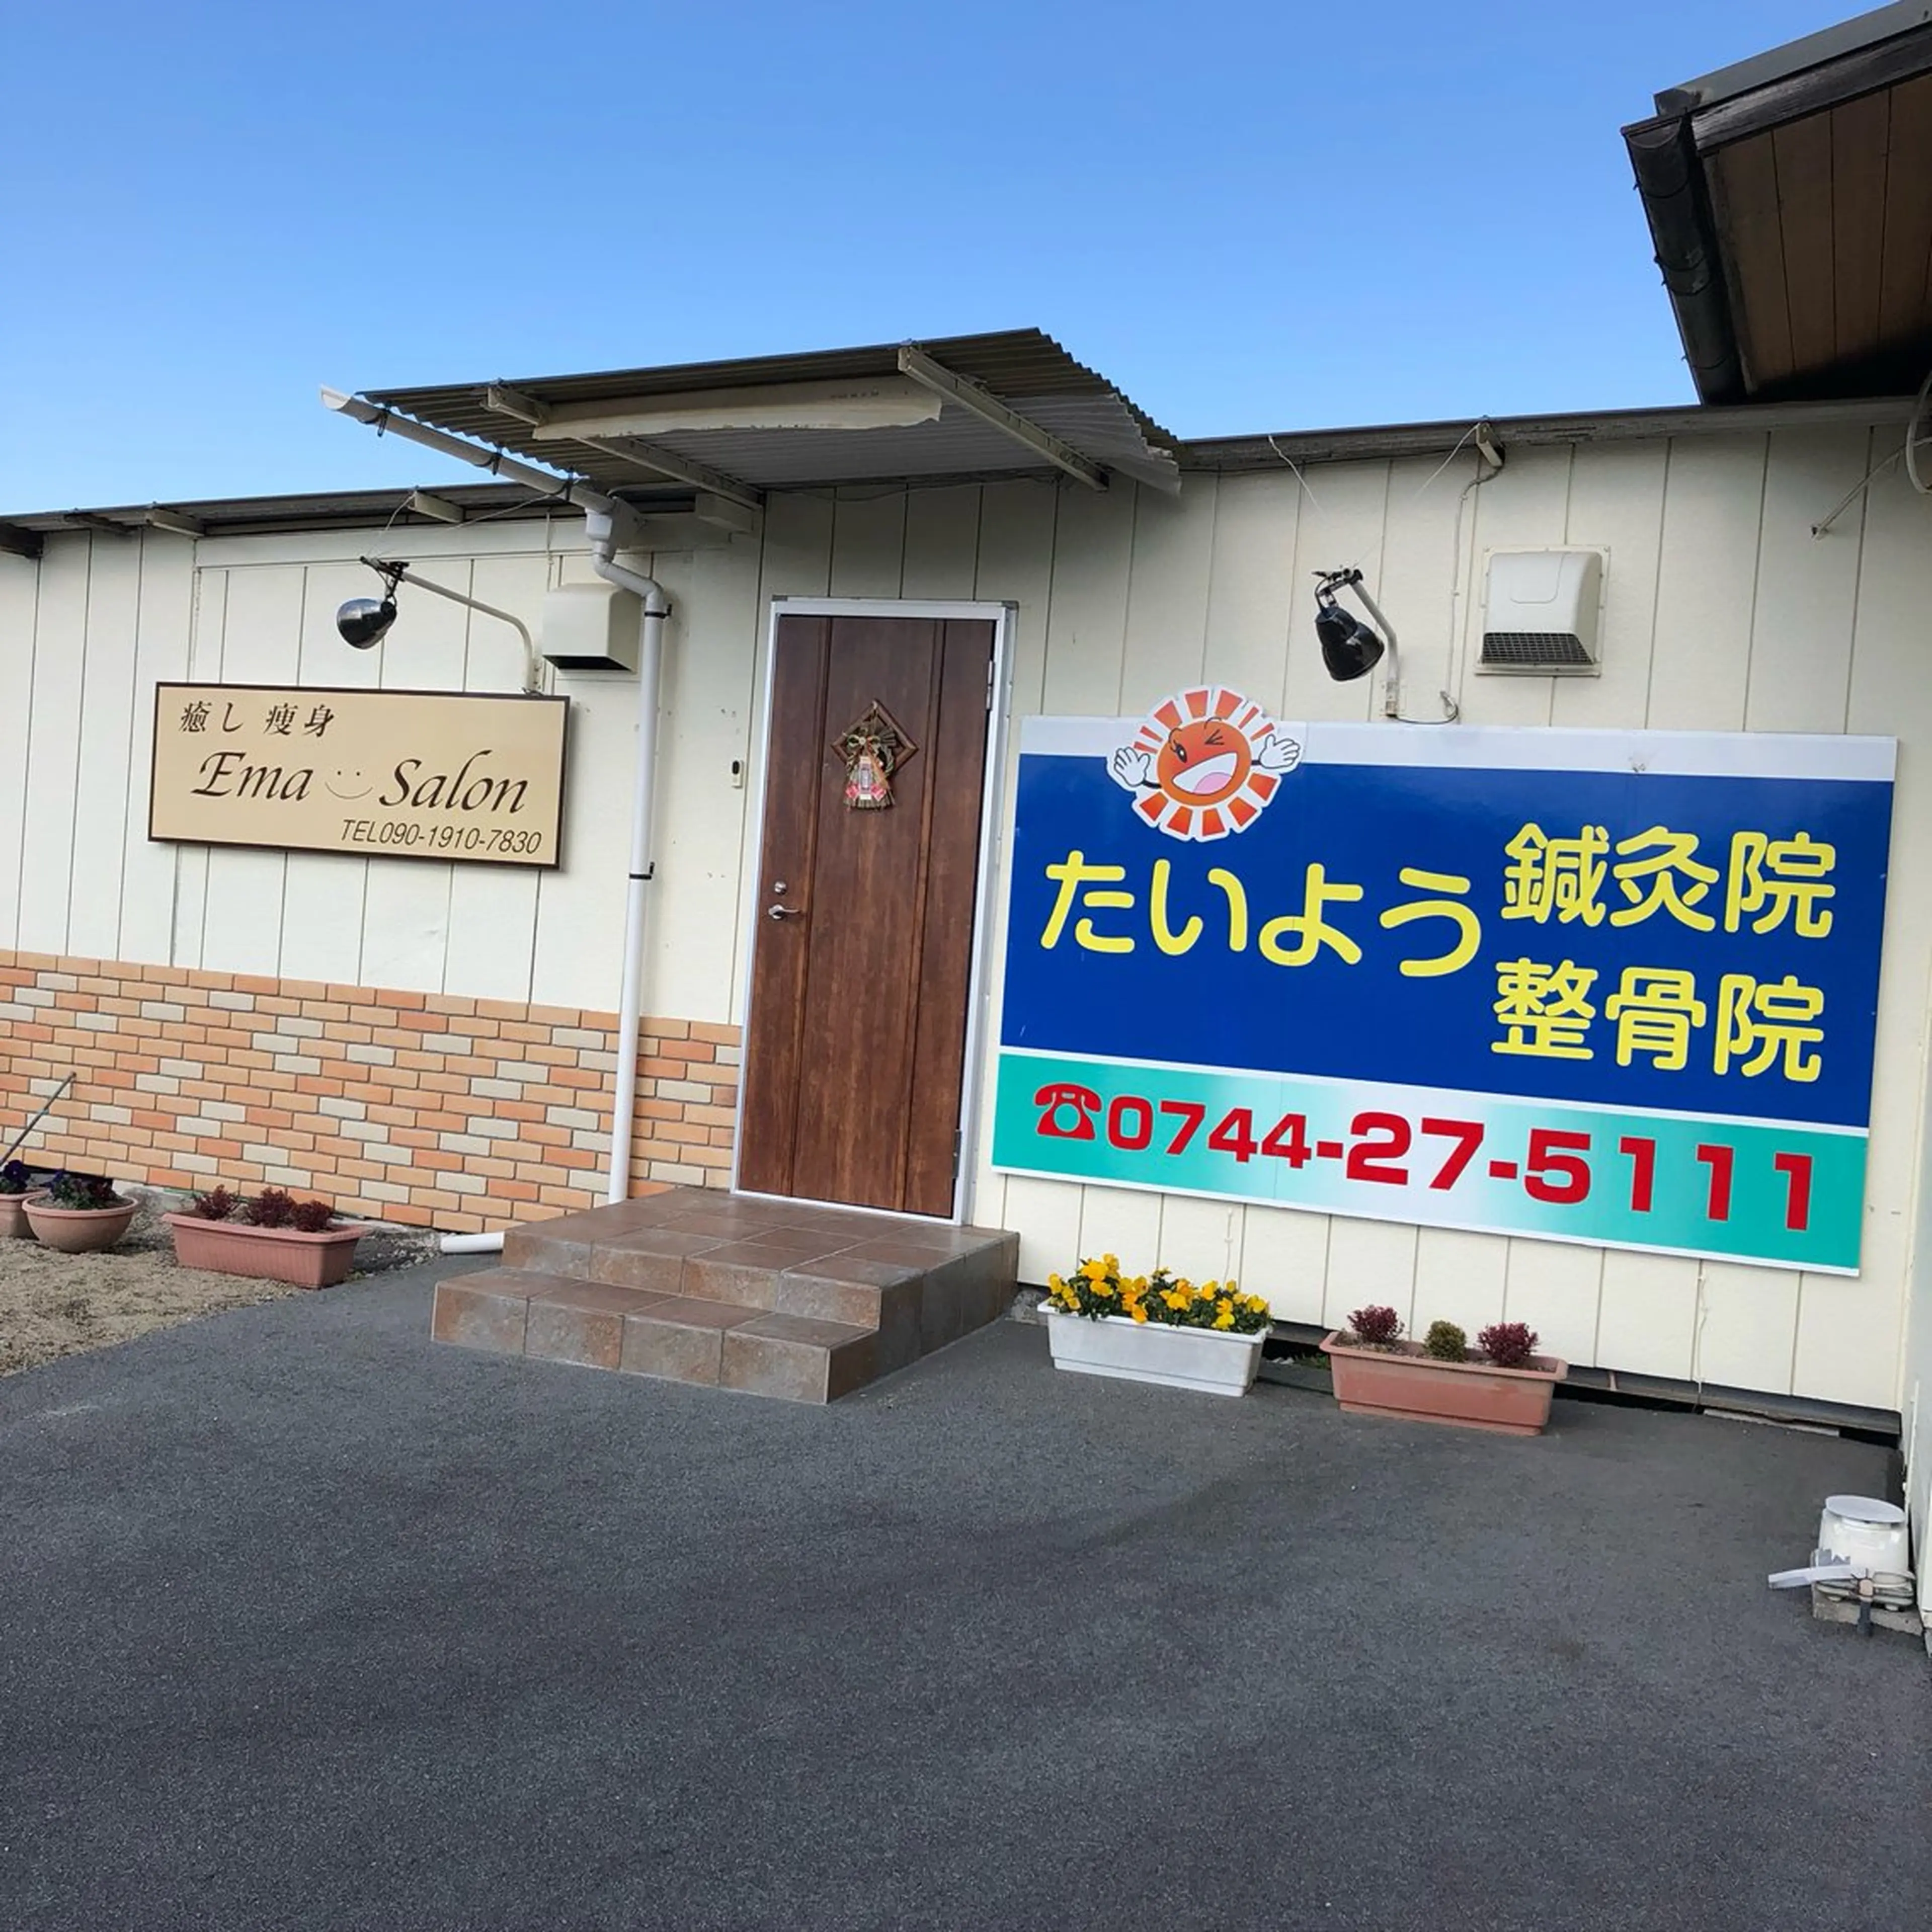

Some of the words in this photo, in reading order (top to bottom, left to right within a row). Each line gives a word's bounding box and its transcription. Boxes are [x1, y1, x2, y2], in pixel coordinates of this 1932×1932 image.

[179, 700, 244, 733] 癒し
[263, 702, 335, 738] 痩身
[191, 751, 314, 802] Ema
[379, 749, 529, 814] Salon
[341, 819, 542, 854] TEL090-1910-7830
[1040, 850, 1481, 977] たいよう
[1501, 823, 1835, 937] 鍼灸院
[1491, 958, 1823, 1082] 整骨院
[1108, 1096, 1812, 1231] 0744-27-5111
